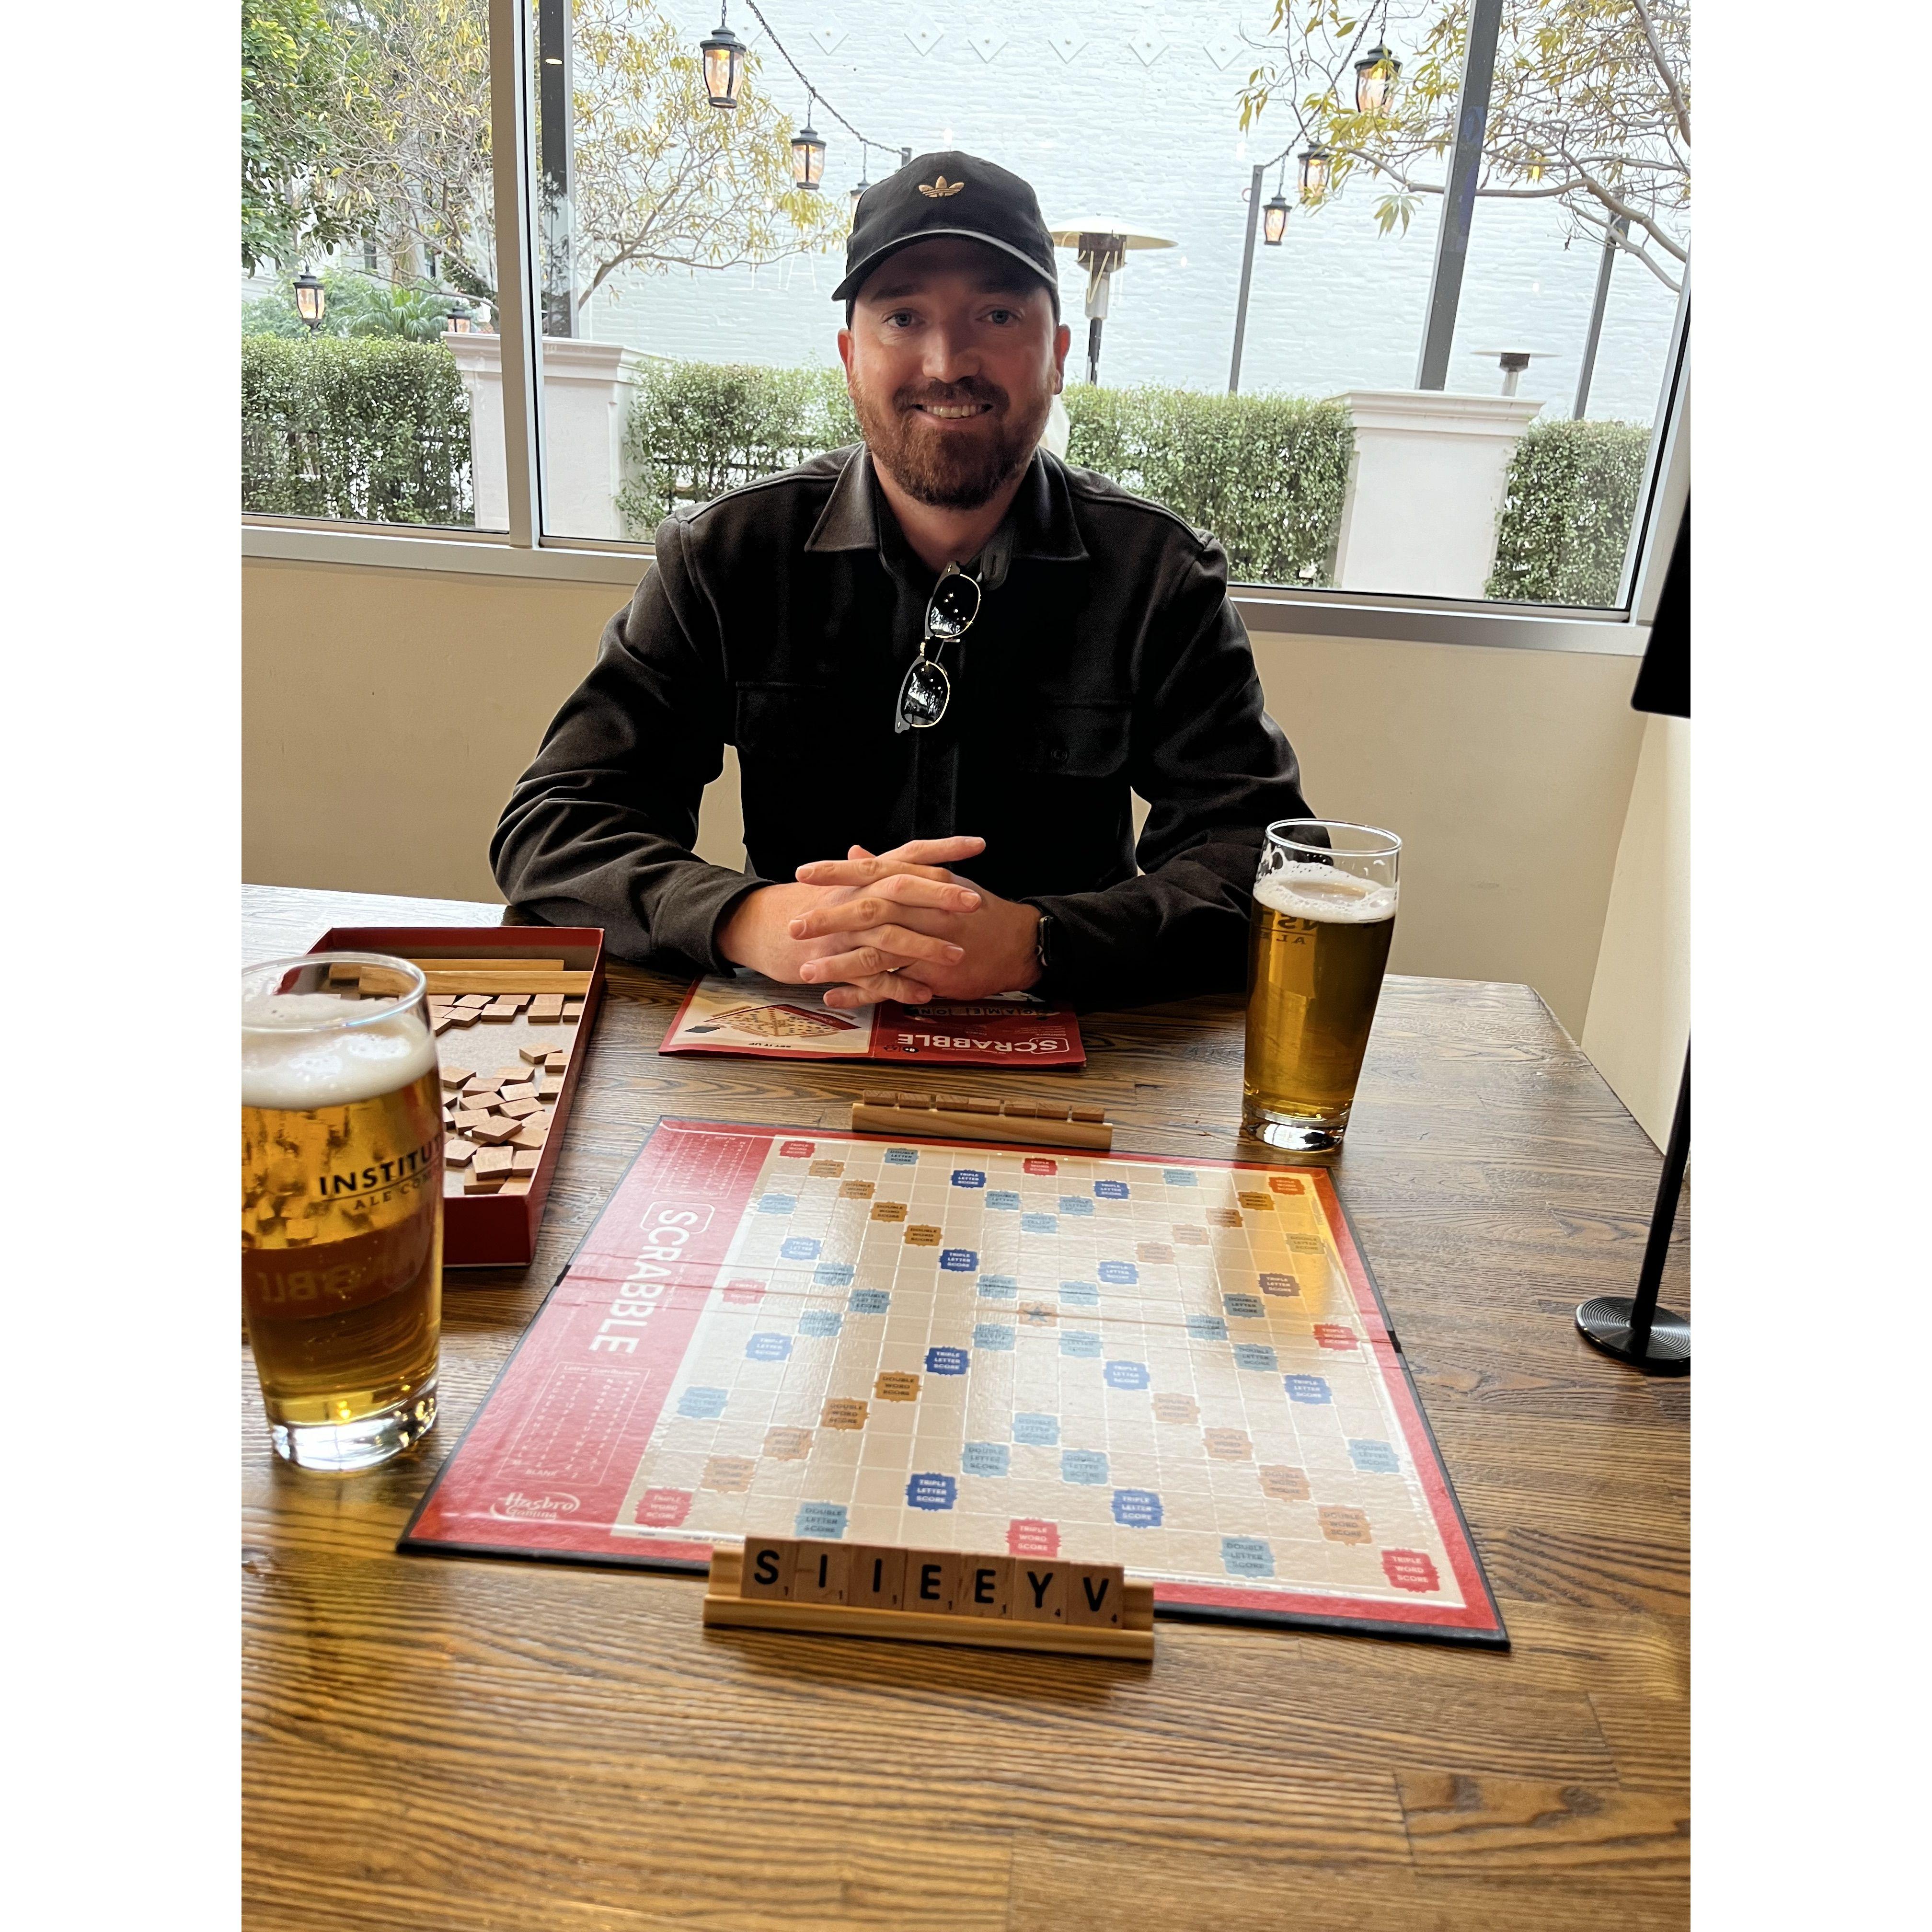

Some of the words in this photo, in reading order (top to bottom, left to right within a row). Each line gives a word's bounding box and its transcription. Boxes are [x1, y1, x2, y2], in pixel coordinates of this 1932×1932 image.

[897, 1034, 1058, 1052] SCRABBLE
[355, 1191, 392, 1209] ALE
[589, 1209, 698, 1354] SCRABBLE
[499, 1492, 574, 1511] Hasbro
[805, 1508, 842, 1516] DOUBLE
[1122, 1504, 1152, 1512] LETTER
[506, 1506, 557, 1520] Gaming
[644, 1512, 676, 1520] SCORE
[806, 1517, 838, 1525] LETTER
[804, 1525, 835, 1533] SCORE
[1020, 1525, 1048, 1533] TRIPLE
[1018, 1542, 1048, 1551] SCORE
[1231, 1552, 1263, 1560] LETTER
[1392, 1556, 1422, 1564] TRIPLE
[1232, 1561, 1264, 1569] SCORE
[1394, 1565, 1425, 1573] WORD
[754, 1549, 780, 1585] S
[818, 1554, 828, 1588] I
[872, 1558, 883, 1593] I
[920, 1564, 942, 1600] E
[974, 1569, 996, 1604] E
[1027, 1571, 1053, 1608] Y
[1082, 1577, 1109, 1612] V
[1396, 1574, 1428, 1582] SCORE
